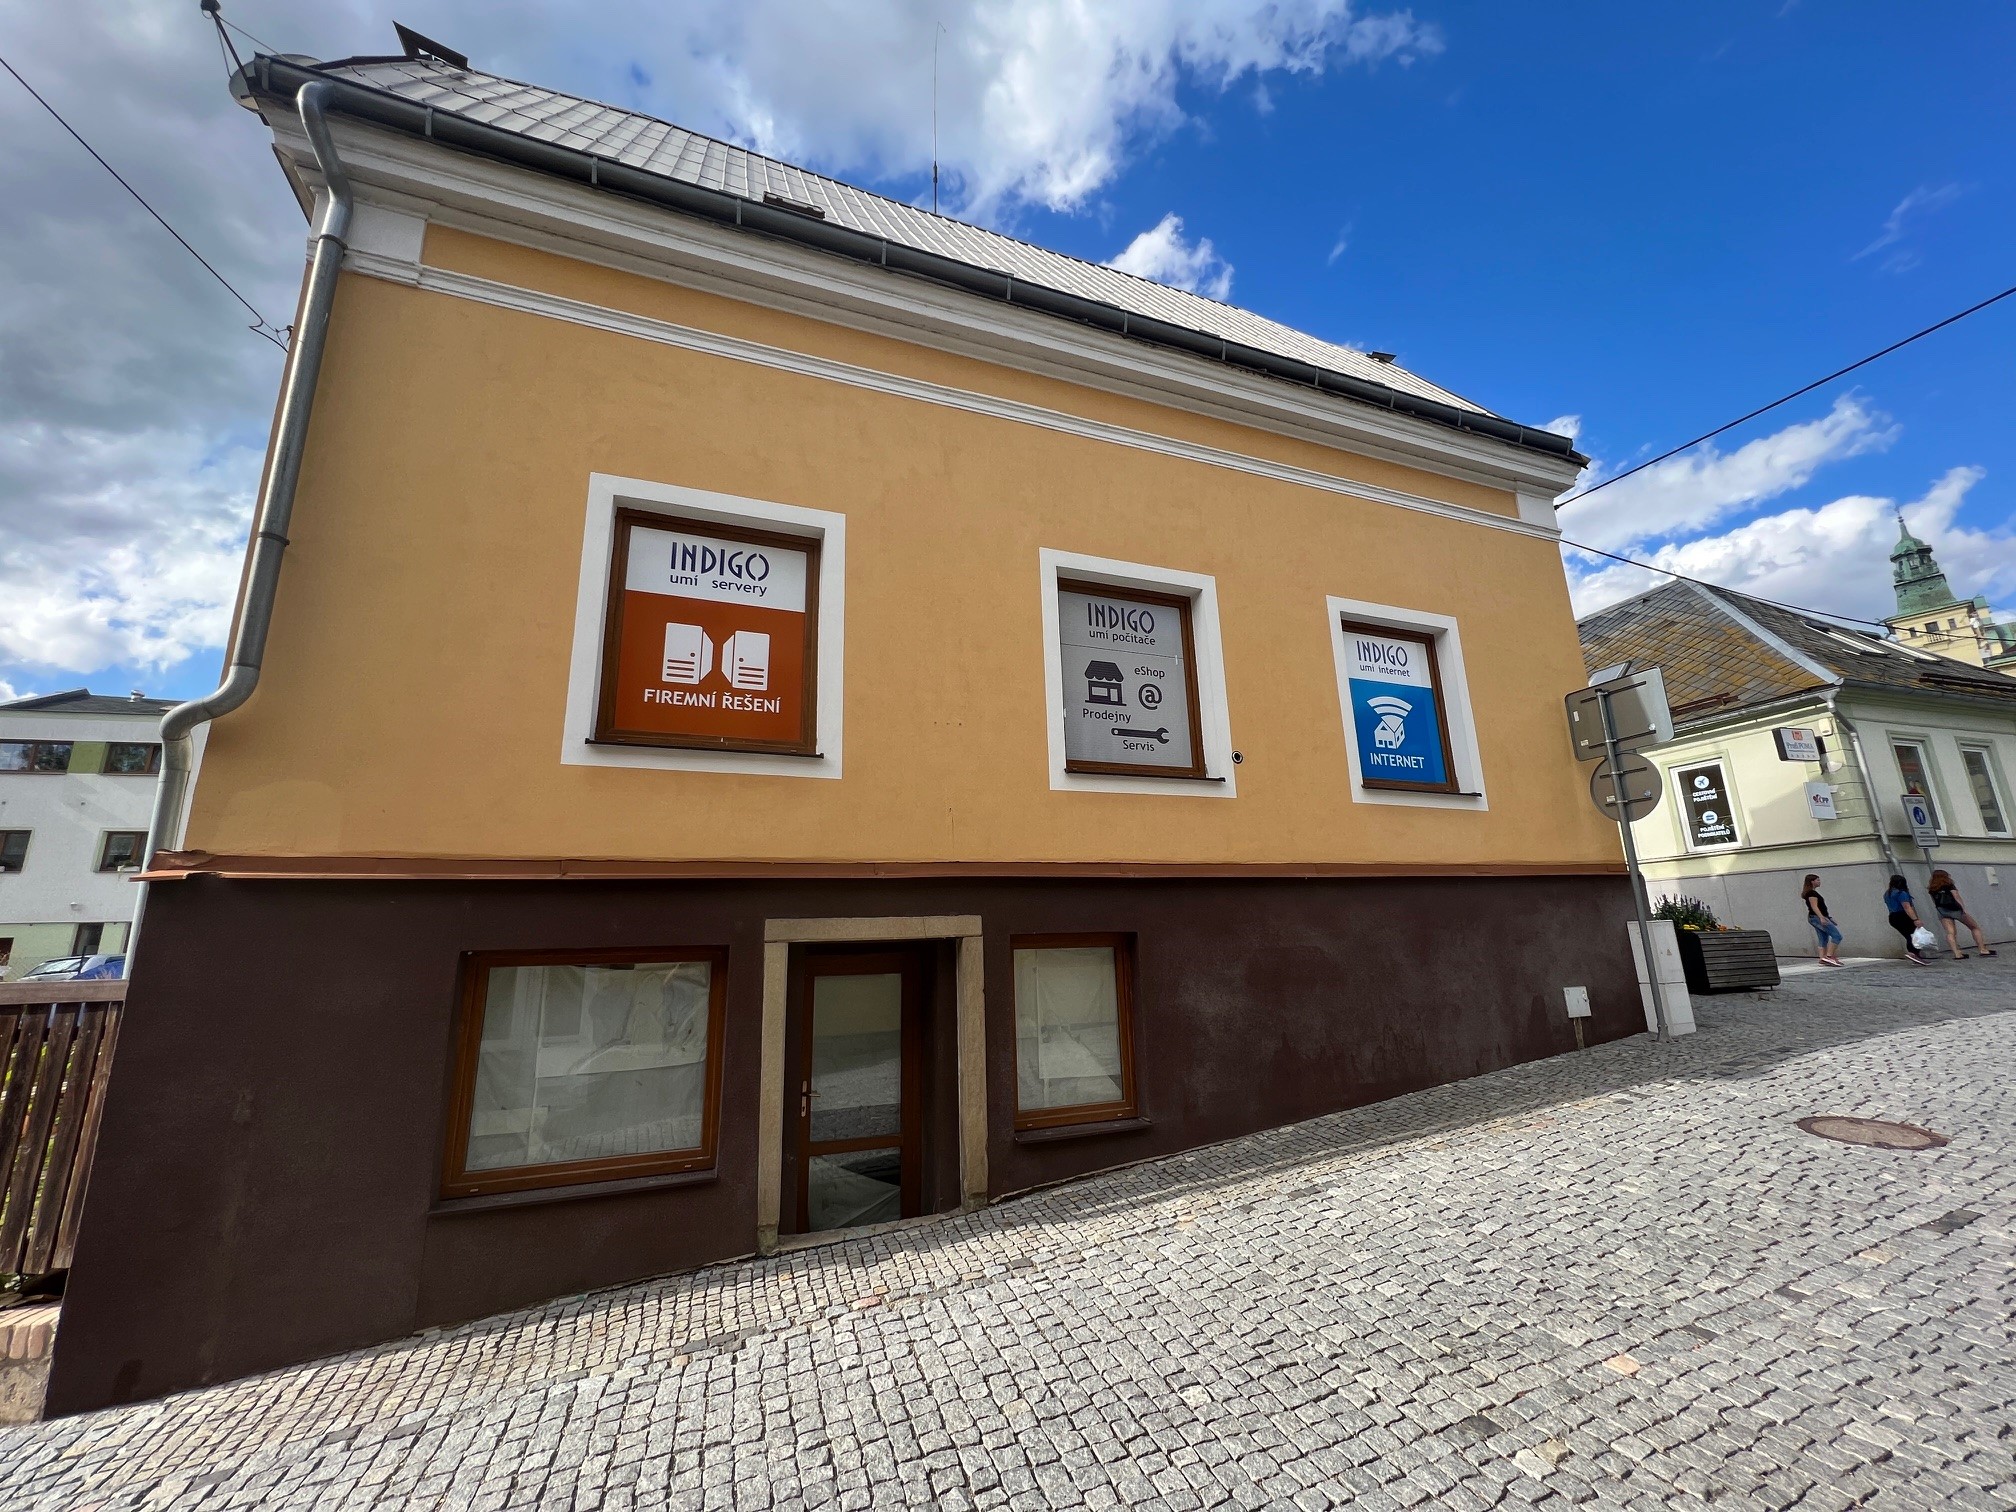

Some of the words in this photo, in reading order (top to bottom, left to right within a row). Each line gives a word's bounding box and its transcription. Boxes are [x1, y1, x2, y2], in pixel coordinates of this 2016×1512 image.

[671, 541, 769, 581] INDIGO
[670, 574, 698, 586] umí
[712, 578, 767, 597] servery
[1087, 602, 1155, 634] INDIGO
[1089, 629, 1109, 640] umí
[1112, 632, 1156, 646] počítače
[1356, 640, 1408, 667] INDIGO
[1134, 666, 1165, 679] eShop
[1378, 665, 1410, 678] internet
[644, 688, 716, 708] FIREMNÍ
[722, 692, 780, 714] ŘEŠENÍ
[1082, 708, 1132, 724] Prodejny
[1122, 739, 1155, 752] Servis
[1370, 752, 1424, 769] INTERNET
